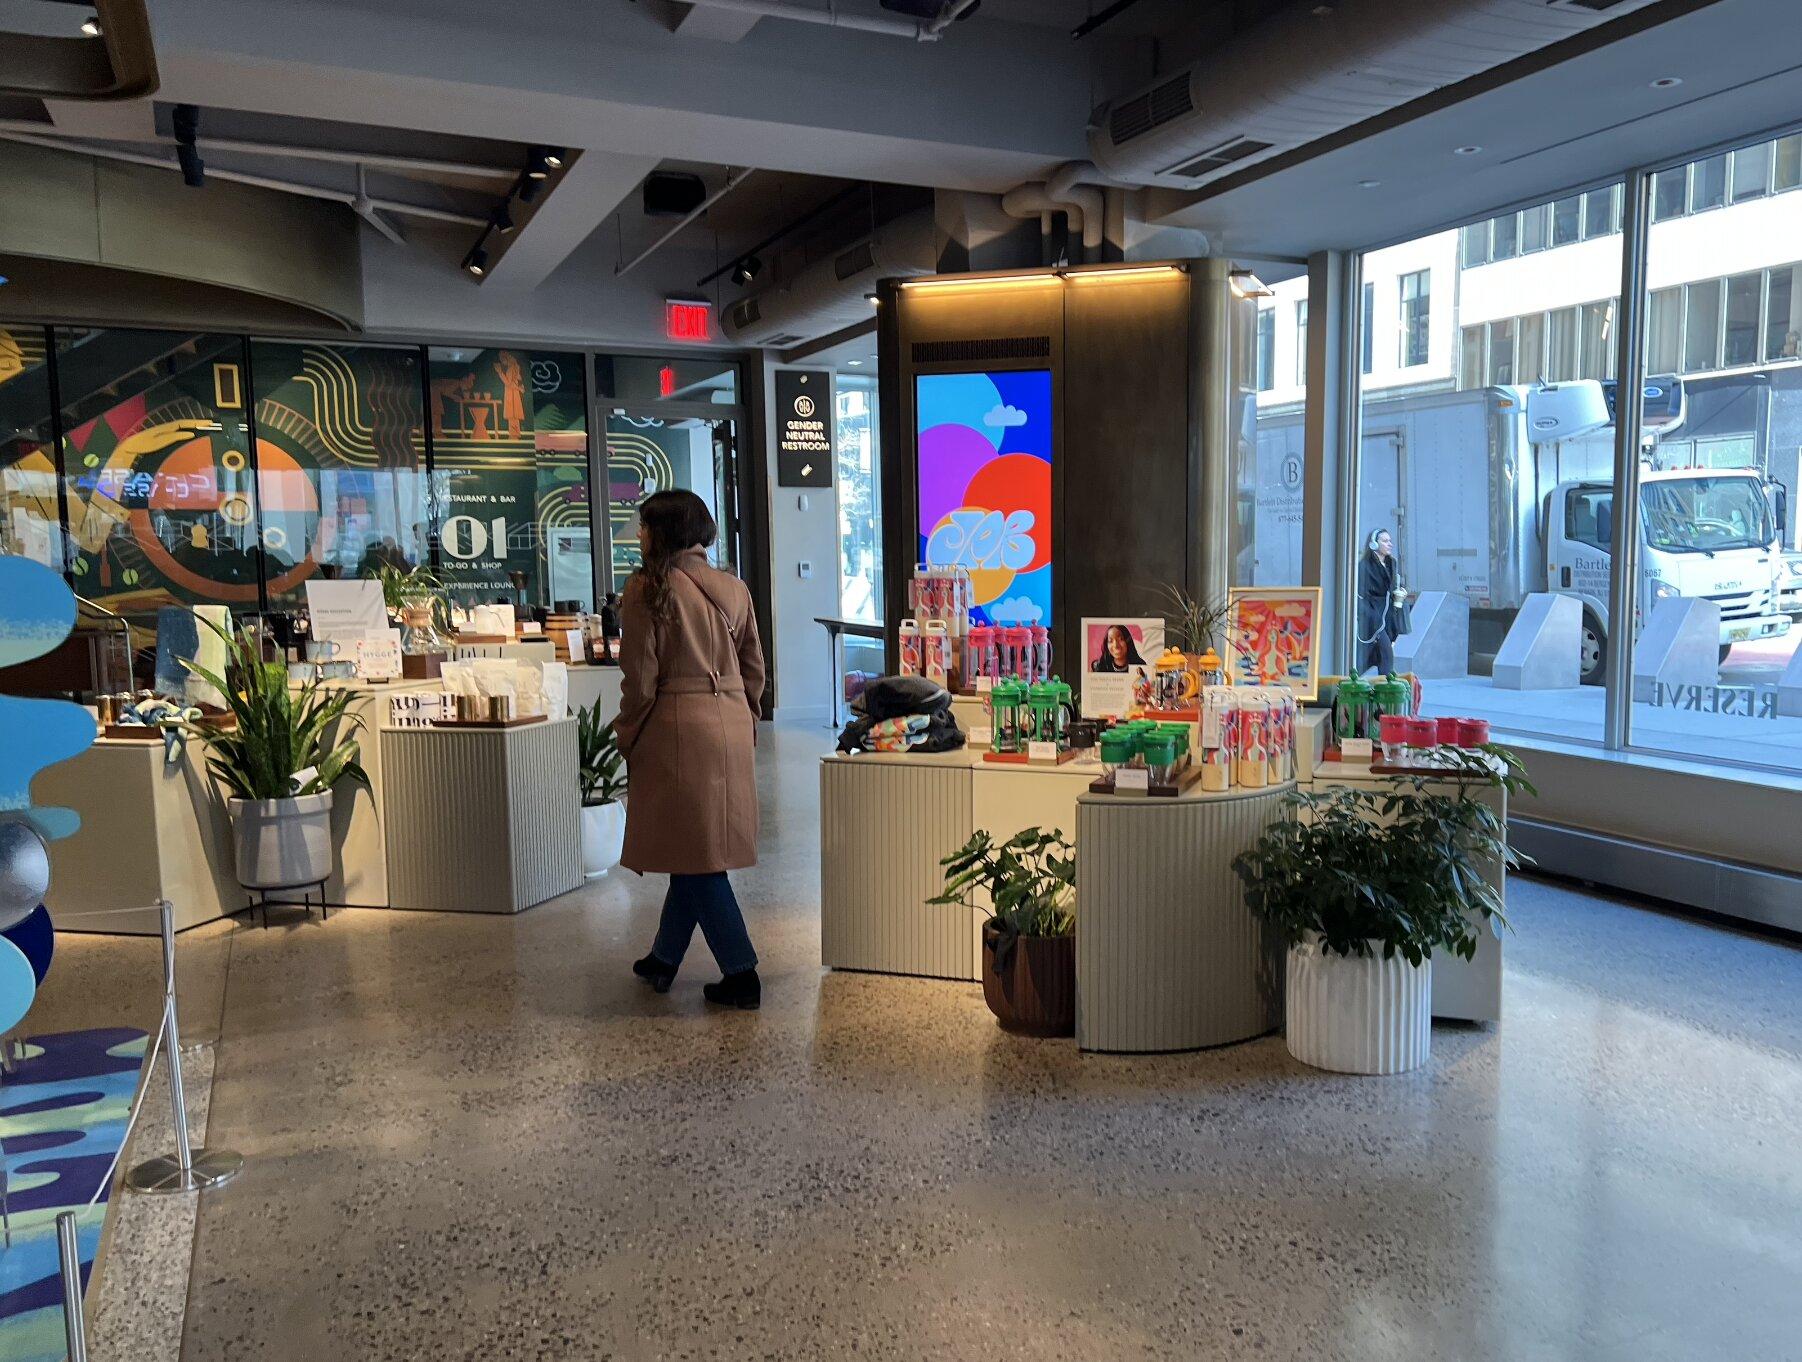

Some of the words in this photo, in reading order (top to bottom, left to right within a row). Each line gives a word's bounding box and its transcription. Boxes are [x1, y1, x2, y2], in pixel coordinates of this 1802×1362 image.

[672, 304, 708, 337] EXIT
[786, 420, 824, 430] GENDER
[785, 431, 826, 440] NEUTRAL
[781, 441, 830, 451] RESTROOM
[1288, 462, 1298, 483] B
[490, 495, 497, 503] &
[500, 495, 516, 503] BAR
[472, 561, 478, 570] &
[481, 562, 502, 570] SHOP
[444, 582, 488, 590] EXPERIENCE
